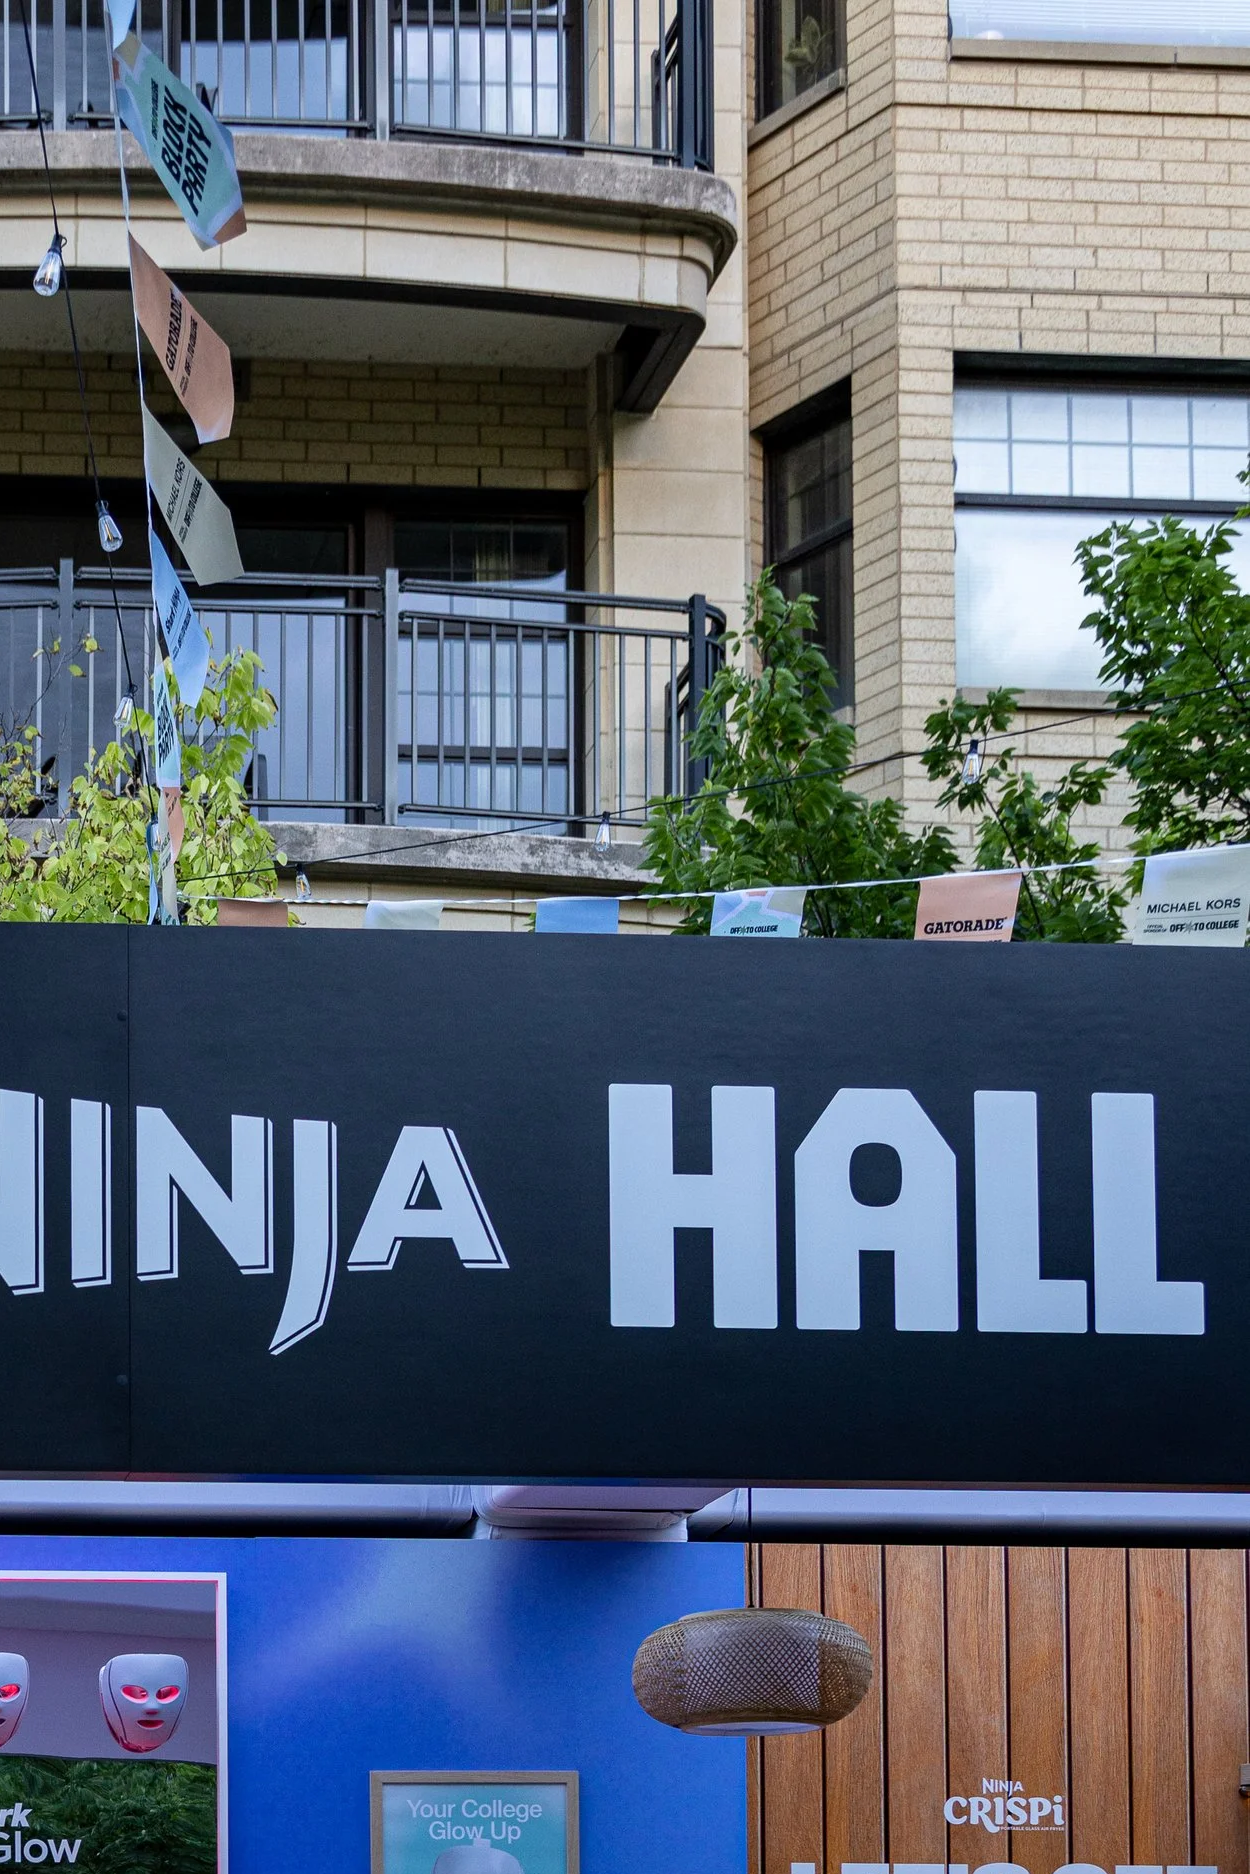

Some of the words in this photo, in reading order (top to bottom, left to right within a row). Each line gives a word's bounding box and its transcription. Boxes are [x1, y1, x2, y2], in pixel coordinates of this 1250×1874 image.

[162, 85, 187, 184] BLOCK
[181, 113, 212, 217] PARTY
[165, 288, 182, 371] GATORADE
[174, 457, 186, 487] KORS
[1146, 901, 1202, 914] MICHAEL
[1205, 898, 1241, 910] KORS
[754, 925, 779, 933] COLLEGE
[924, 919, 1005, 935] GATORADE
[1169, 923, 1185, 933] OFF
[1194, 922, 1205, 931] TO
[1206, 920, 1240, 930] COLLEGE
[608, 1084, 1205, 1335] HALL
[982, 1777, 1024, 1796] NINJA
[406, 1800, 456, 1818] Your
[461, 1799, 543, 1822] College
[429, 1821, 484, 1840] Glow
[491, 1821, 521, 1844] Up
